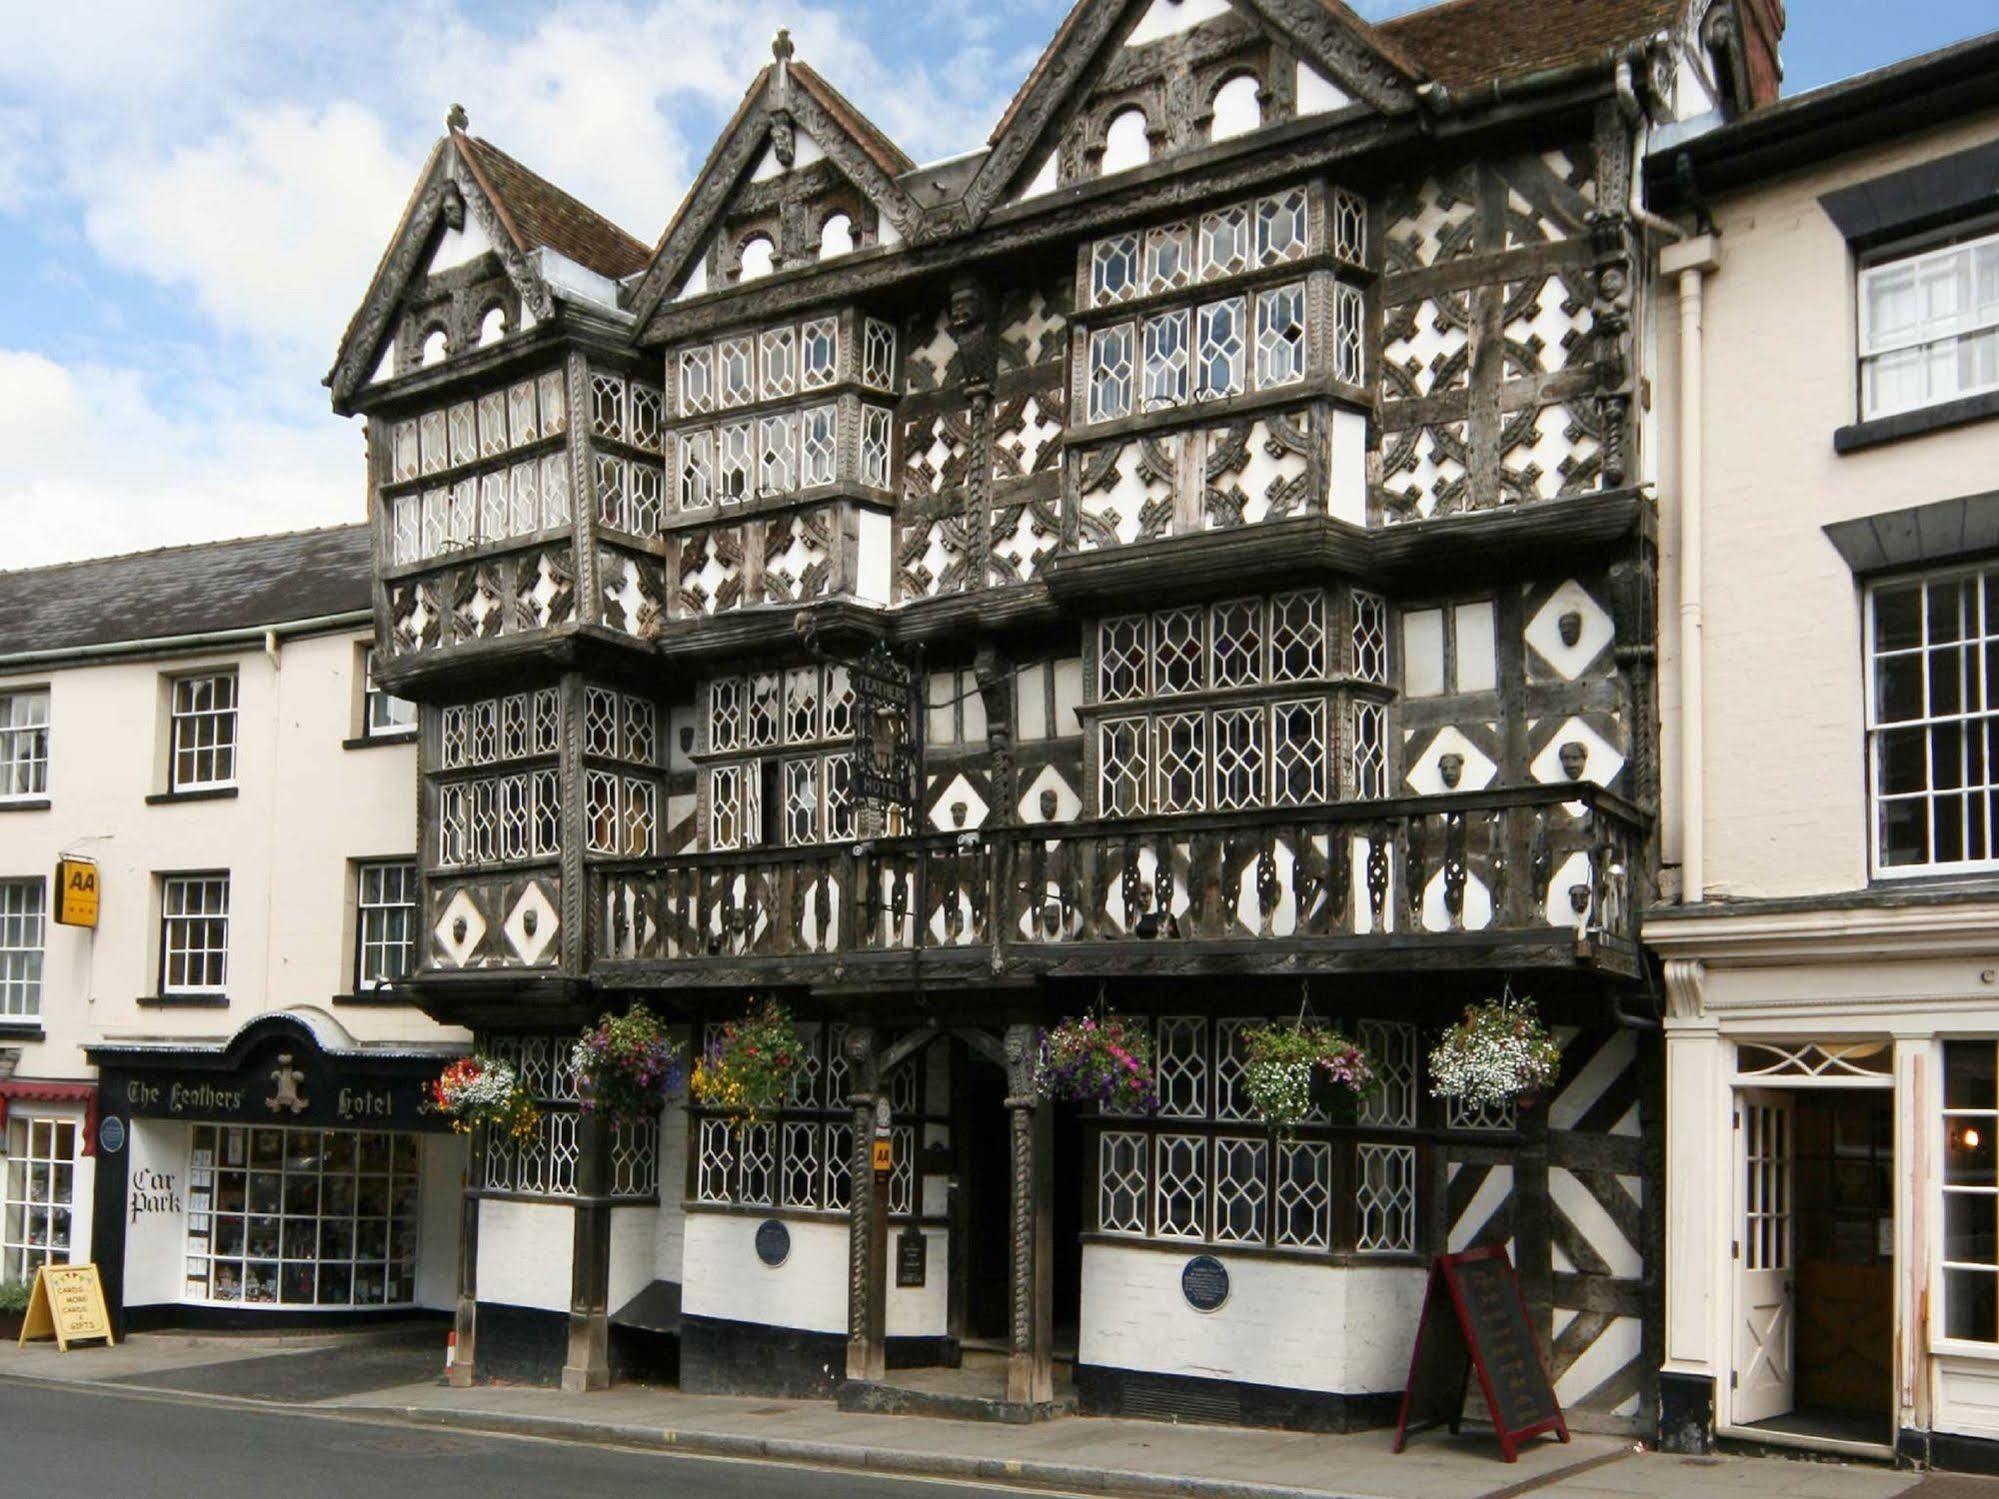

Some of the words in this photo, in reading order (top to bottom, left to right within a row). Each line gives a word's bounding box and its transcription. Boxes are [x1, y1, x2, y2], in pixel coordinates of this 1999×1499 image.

[863, 777, 902, 799] HOTEL
[70, 871, 95, 892] AA
[127, 1081, 159, 1107] The
[338, 1088, 392, 1119] Hotel
[876, 1149, 890, 1162] AA
[133, 1168, 175, 1191] Car
[131, 1192, 181, 1223] Park
